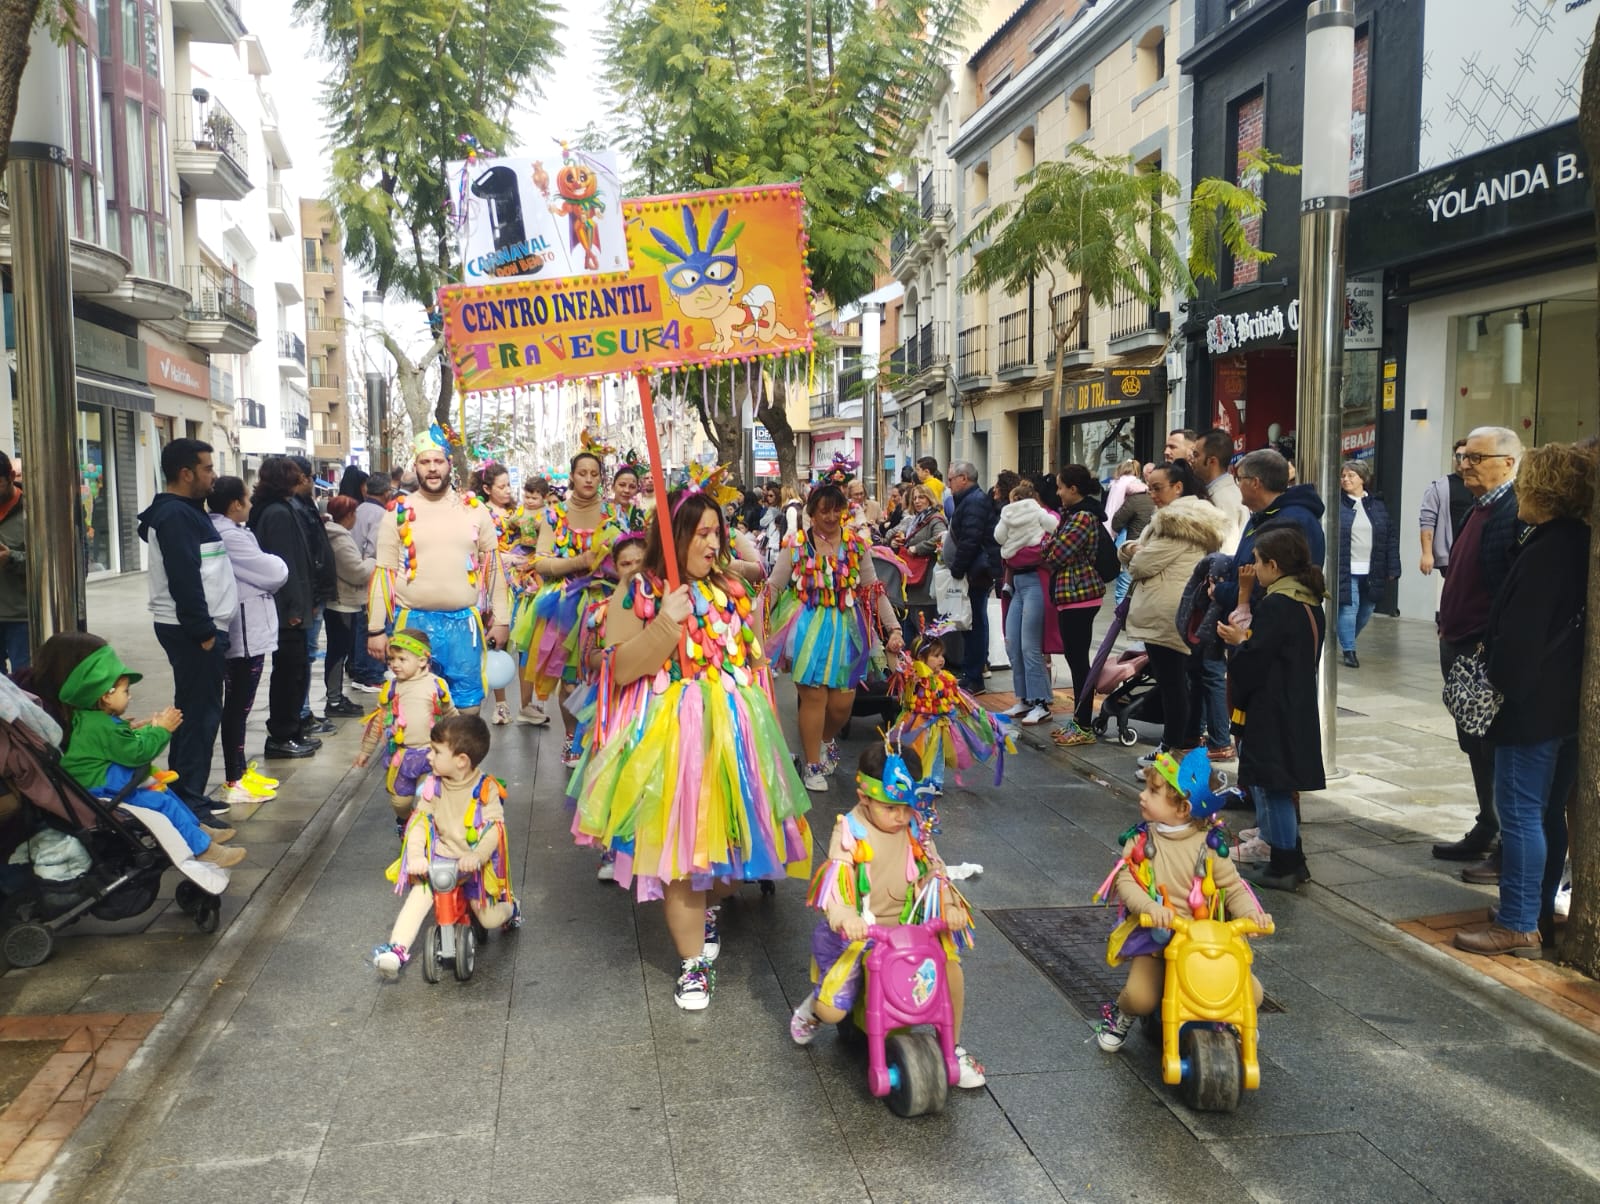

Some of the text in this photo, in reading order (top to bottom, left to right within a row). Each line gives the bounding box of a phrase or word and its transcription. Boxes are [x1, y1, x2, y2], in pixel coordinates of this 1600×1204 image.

[1427, 153, 1584, 223] YOLANDA B.
[467, 234, 551, 277] CARNAVAL
[495, 262, 519, 278] DON
[461, 284, 652, 333] CENTRO INFANTIL
[1235, 304, 1285, 343] British
[464, 319, 694, 371] TRAVESURAS
[1341, 429, 1376, 452] EBAJA
